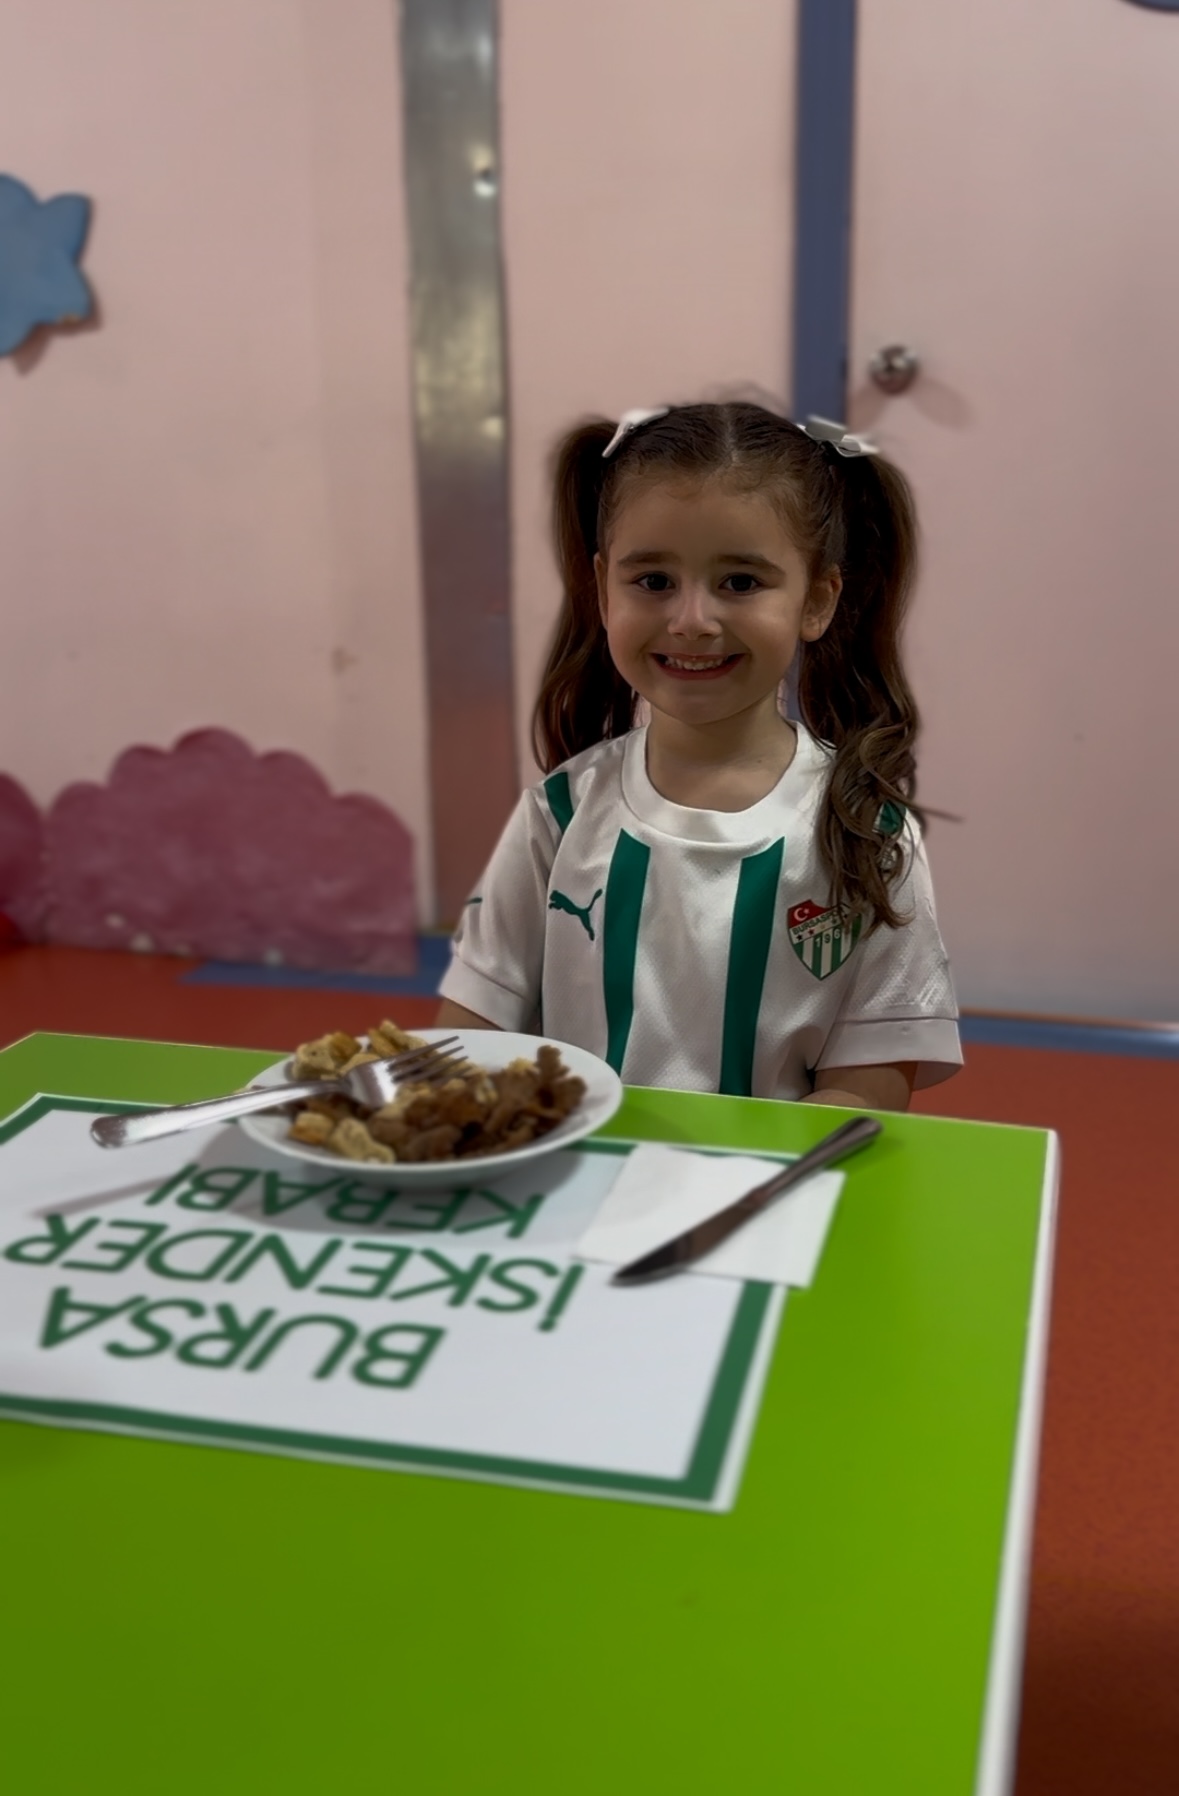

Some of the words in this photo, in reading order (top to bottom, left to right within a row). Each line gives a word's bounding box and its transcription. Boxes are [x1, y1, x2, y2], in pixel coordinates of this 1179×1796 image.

[791, 909, 842, 936] BURSASPO
[814, 928, 841, 948] 196
[144, 1164, 546, 1239] KEBABI
[2, 1212, 585, 1332] İSKENDER
[39, 1286, 446, 1389] BURSA
